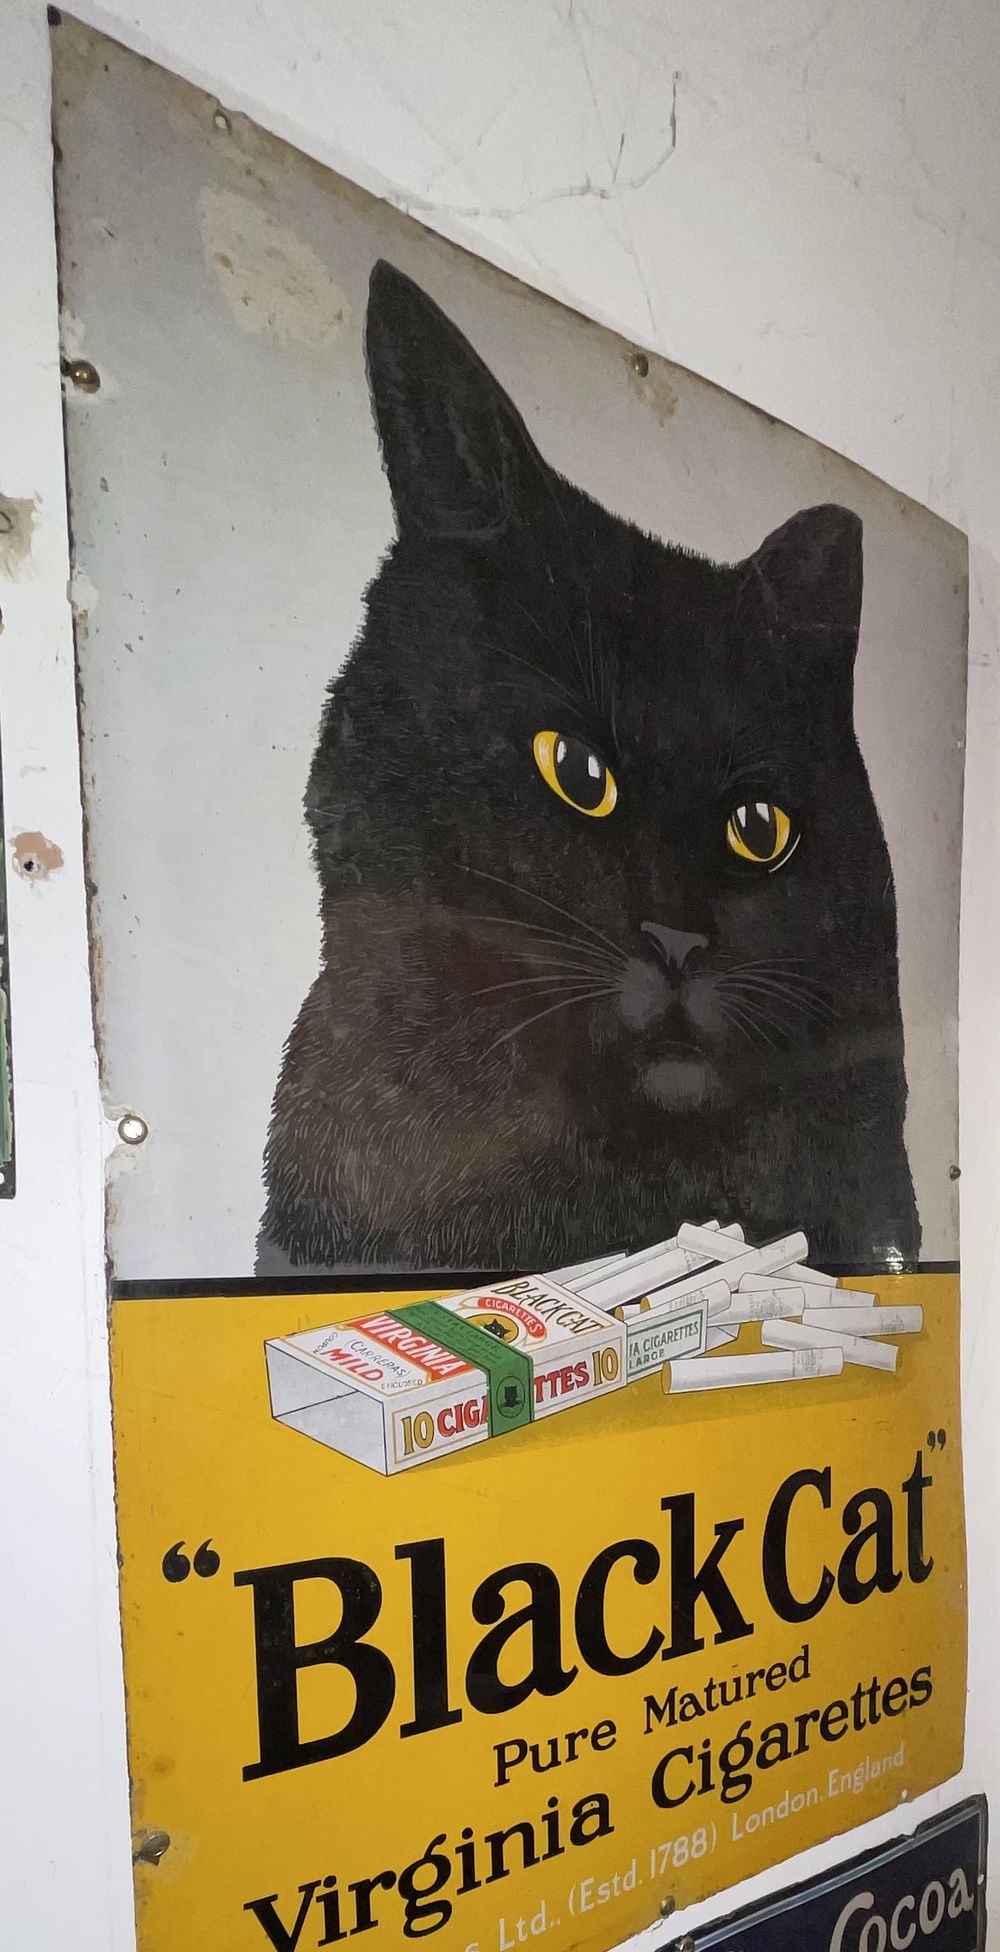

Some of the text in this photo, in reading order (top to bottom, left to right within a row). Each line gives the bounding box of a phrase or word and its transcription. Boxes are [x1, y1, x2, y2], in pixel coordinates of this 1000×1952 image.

[360, 1314, 467, 1376] VIRGINIA
[485, 1298, 543, 1334] CIGARETTES
[643, 1321, 699, 1353] CIGARETTES
[320, 1346, 384, 1381] MILD
[628, 1348, 665, 1370] LARGE
[401, 1410, 435, 1456] 10
[592, 1347, 619, 1387] 10
[493, 1644, 811, 1788] Pure Matured
[243, 1665, 934, 1952] Virginia Cigarettes
[568, 1857, 643, 1917] (Estd.
[650, 1821, 718, 1880] 1788)
